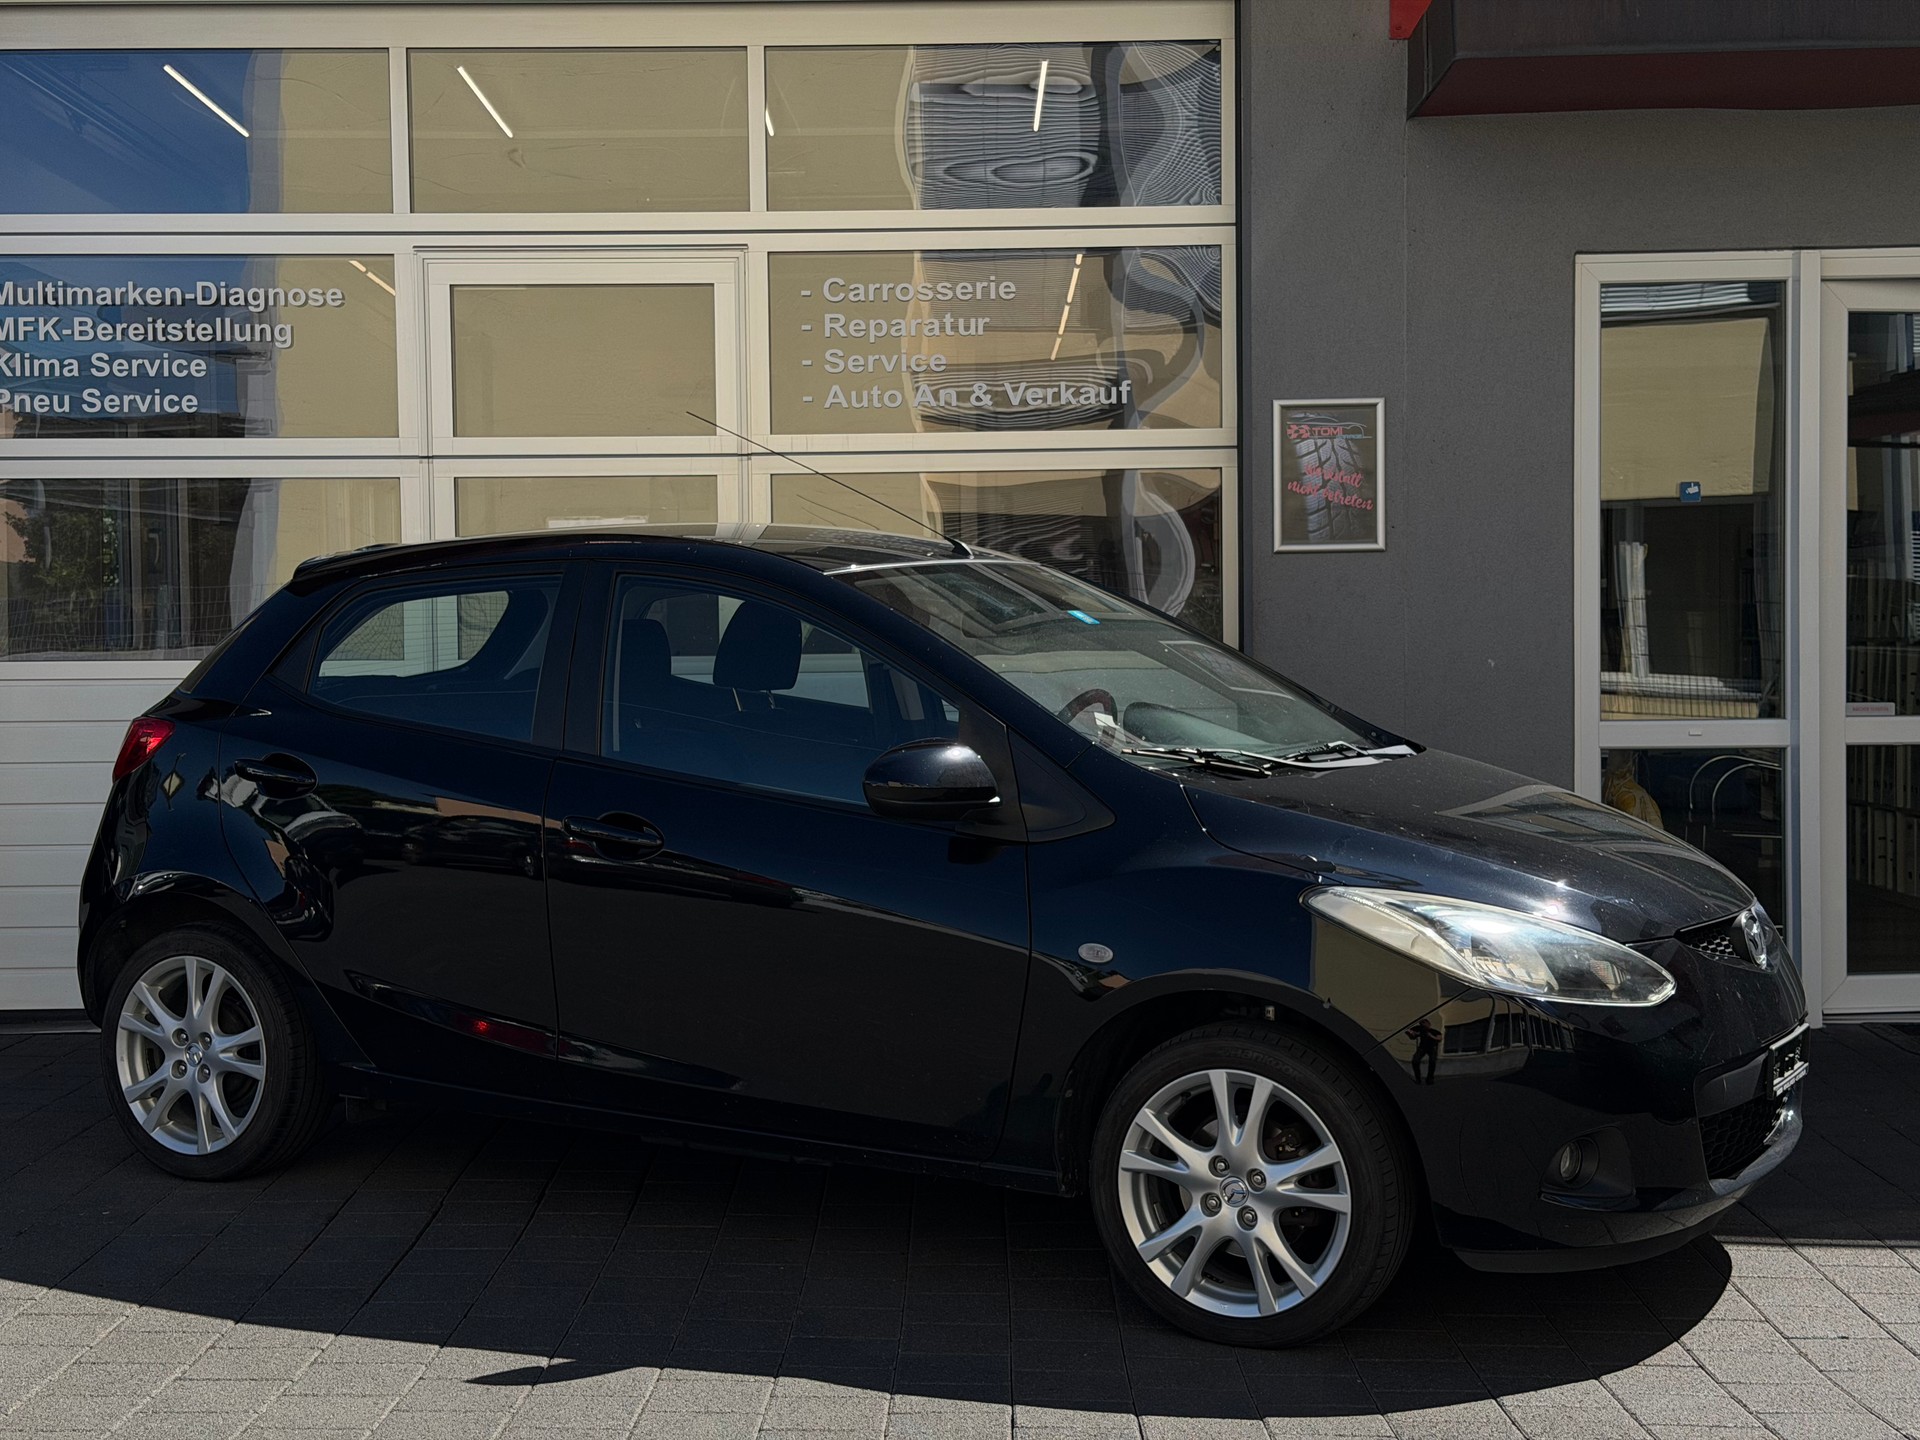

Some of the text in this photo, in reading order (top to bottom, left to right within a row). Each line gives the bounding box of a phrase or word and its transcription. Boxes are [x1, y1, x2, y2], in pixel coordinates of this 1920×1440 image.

[0, 281, 344, 312] Multimarken-Diagnose
[822, 276, 1017, 302] Carrosserie
[0, 316, 293, 347] MFK-Bereitstellung
[823, 312, 990, 342] Reparatur
[0, 353, 207, 377] Klima Service
[824, 349, 947, 373] Service
[81, 388, 199, 413] Service
[824, 385, 903, 408] Auto
[914, 384, 957, 407] An
[969, 382, 993, 407] &
[1003, 380, 1131, 405] Verkauf
[1312, 426, 1344, 437] TOMI
[1288, 480, 1374, 510] nicht betreten
